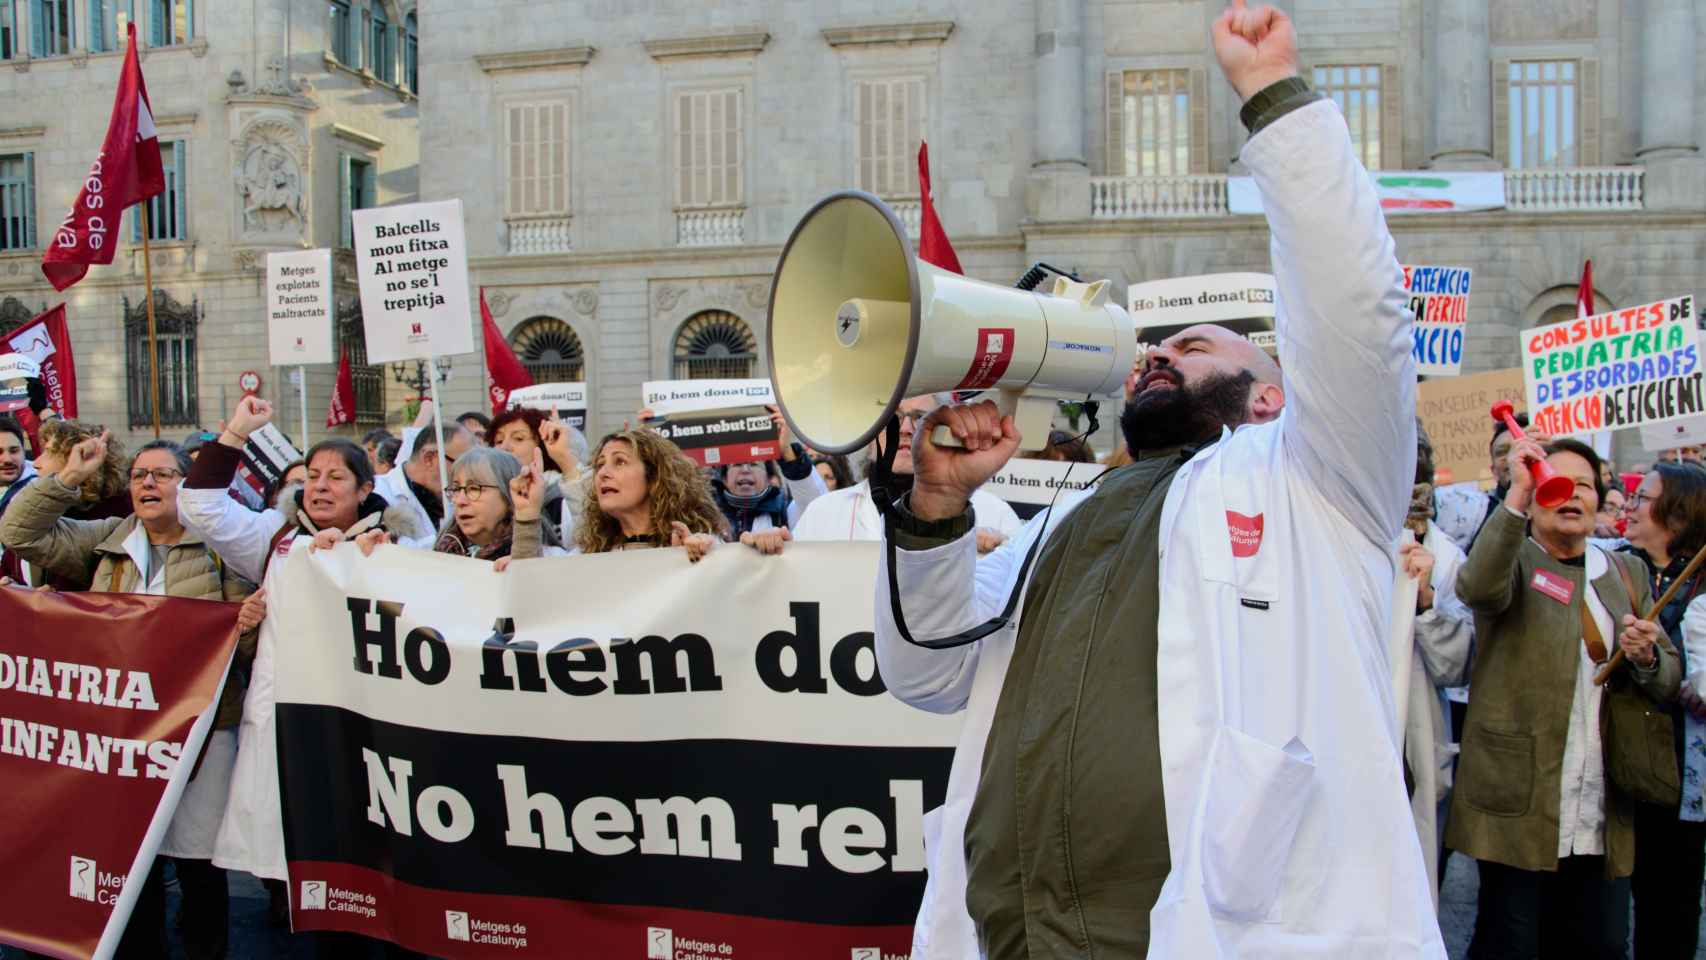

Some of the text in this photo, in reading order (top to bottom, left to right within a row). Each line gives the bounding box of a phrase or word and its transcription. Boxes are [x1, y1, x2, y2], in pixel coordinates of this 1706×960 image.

[88, 216, 107, 250] de
[375, 219, 441, 239] Balcells
[370, 238, 449, 257] mou fitxa
[280, 266, 315, 277] Metges
[374, 257, 448, 275] Al metge
[275, 279, 320, 292] explotats
[386, 273, 439, 292] no se'l
[278, 294, 318, 305] Pacients
[384, 292, 445, 311] trepitja
[1134, 288, 1273, 312] Ho hem donat tot
[1425, 295, 1466, 323] PERILL
[272, 308, 325, 319] maltractats
[1528, 297, 1691, 353] CONSULTES DE
[1533, 324, 1683, 379] PEDIATRIA
[1537, 344, 1697, 404] DESBORDADES
[671, 391, 700, 401] hem
[704, 387, 744, 397] donat
[1604, 372, 1704, 426] DEFICIENT
[672, 424, 704, 438] hem
[706, 419, 746, 434] rebut
[747, 417, 771, 431] res
[1009, 474, 1040, 487] hem
[346, 597, 888, 697] Ho hem do
[0, 653, 160, 711] DIATRIA
[0, 717, 183, 780] INFANTS
[362, 746, 475, 843] No
[496, 763, 742, 861] hem
[328, 887, 376, 905] Metges de
[328, 900, 377, 918] Catalunya
[471, 919, 526, 934] Metges de
[471, 932, 527, 948] Catalunya
[674, 937, 732, 954] Metges de
